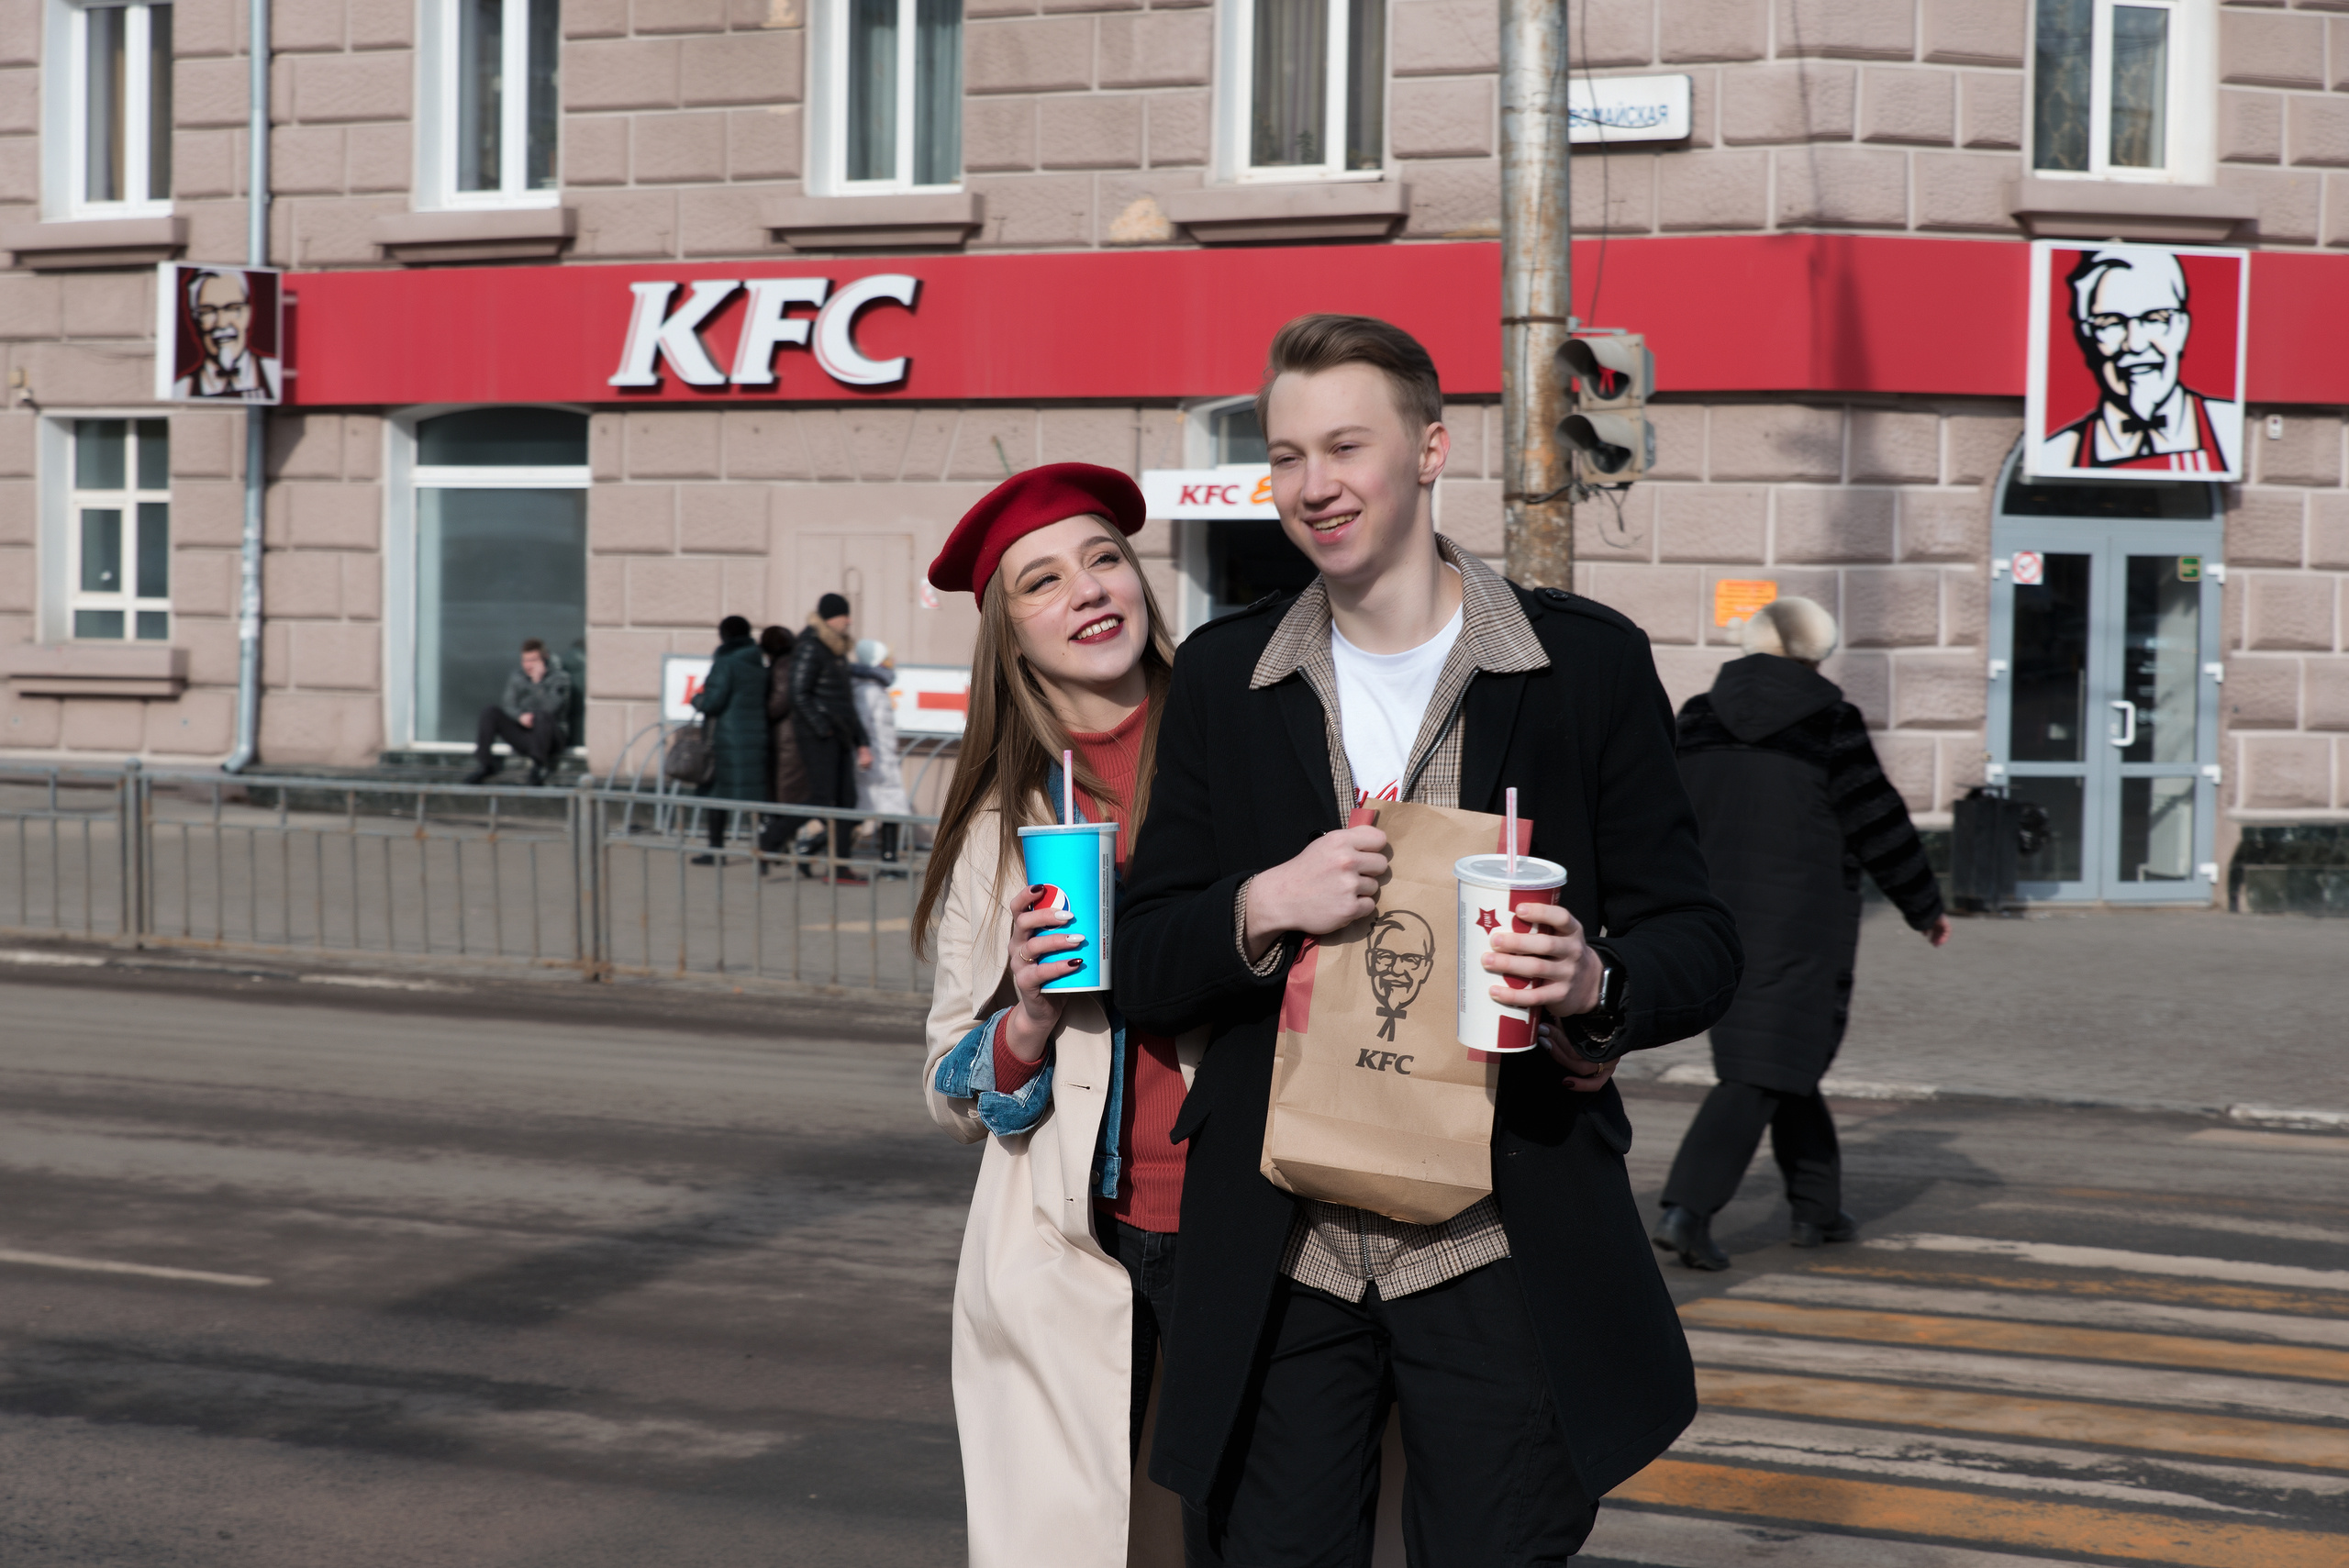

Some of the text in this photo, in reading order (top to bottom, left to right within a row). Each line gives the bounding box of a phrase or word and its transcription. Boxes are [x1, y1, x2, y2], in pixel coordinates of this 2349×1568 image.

[607, 273, 918, 386] KFC
[1178, 484, 1240, 506] KFC
[1354, 1048, 1415, 1075] KFC
